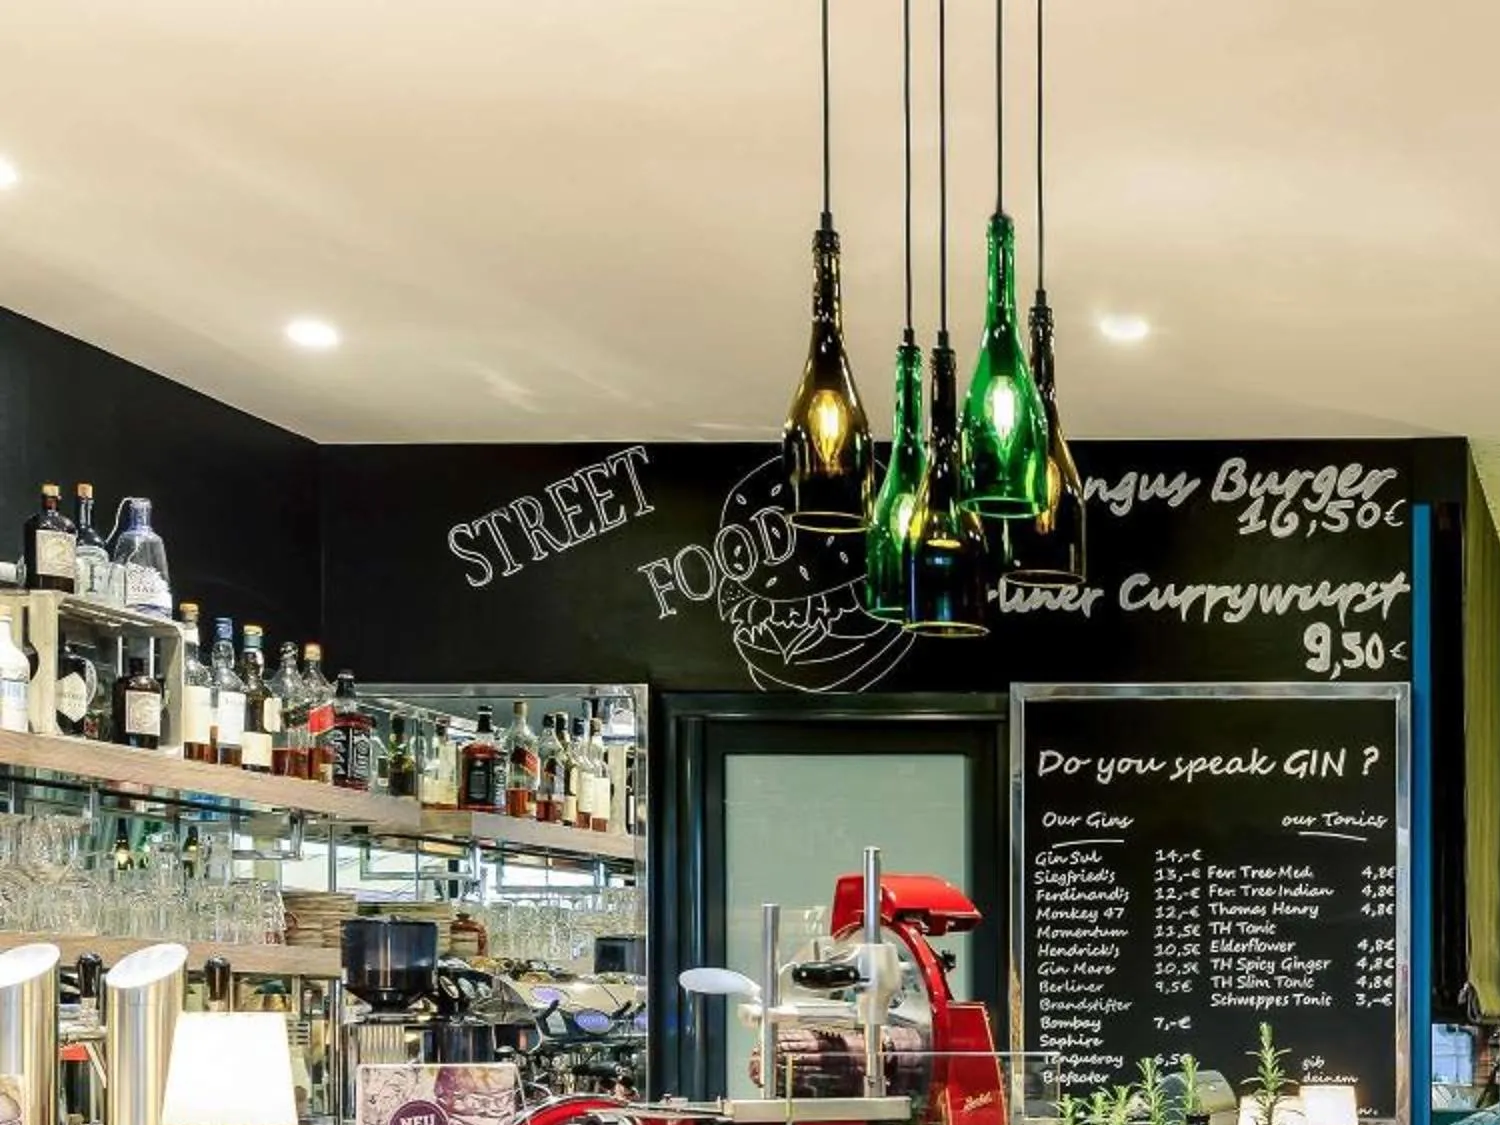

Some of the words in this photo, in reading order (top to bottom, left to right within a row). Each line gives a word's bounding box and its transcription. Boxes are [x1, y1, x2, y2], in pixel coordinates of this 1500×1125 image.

[1082, 471, 1201, 517] ngus
[1211, 457, 1399, 512] Burger
[447, 444, 656, 588] STREET
[1237, 499, 1407, 539] 16,50€
[637, 506, 797, 620] FOOD
[986, 574, 1106, 620] liner
[1119, 571, 1411, 627] Currywurst
[1303, 621, 1408, 681] 9,50€
[1038, 749, 1092, 777] Do
[1096, 757, 1167, 785] you
[1169, 747, 1277, 784] speak
[1283, 747, 1347, 779] GIN
[1361, 745, 1380, 776] ?
[1041, 811, 1082, 828] Our
[1085, 811, 1134, 829] Gins
[1281, 815, 1317, 827] our
[1321, 810, 1389, 829] Tonics
[1035, 850, 1069, 867] Gin
[1239, 865, 1277, 879] Tree
[1239, 883, 1277, 897] Tree
[1277, 883, 1335, 897] Indian
[1035, 906, 1099, 924] Monkey
[1103, 906, 1125, 919] 47
[1207, 901, 1267, 917] Thomas
[1271, 901, 1320, 920] Henry
[1036, 925, 1129, 939] Momentum
[1207, 920, 1233, 935] TH
[1235, 919, 1277, 935] Tonic
[1209, 937, 1297, 953] Elderflower
[1037, 961, 1070, 977] Gin
[1072, 961, 1116, 975] Mare
[1209, 957, 1233, 971] TH
[1235, 956, 1276, 974] Spicy
[1280, 955, 1332, 975] Ginger
[1039, 979, 1105, 993] Berliner
[1209, 975, 1233, 989] TH
[1236, 974, 1271, 990] Slim
[1273, 973, 1315, 989] Tonic
[1039, 997, 1133, 1015] Brandstifter
[1210, 991, 1290, 1011] Schweppes
[1291, 991, 1333, 1007] Tonic
[1039, 1015, 1102, 1033] Bombay
[1039, 1033, 1104, 1050] Saphire
